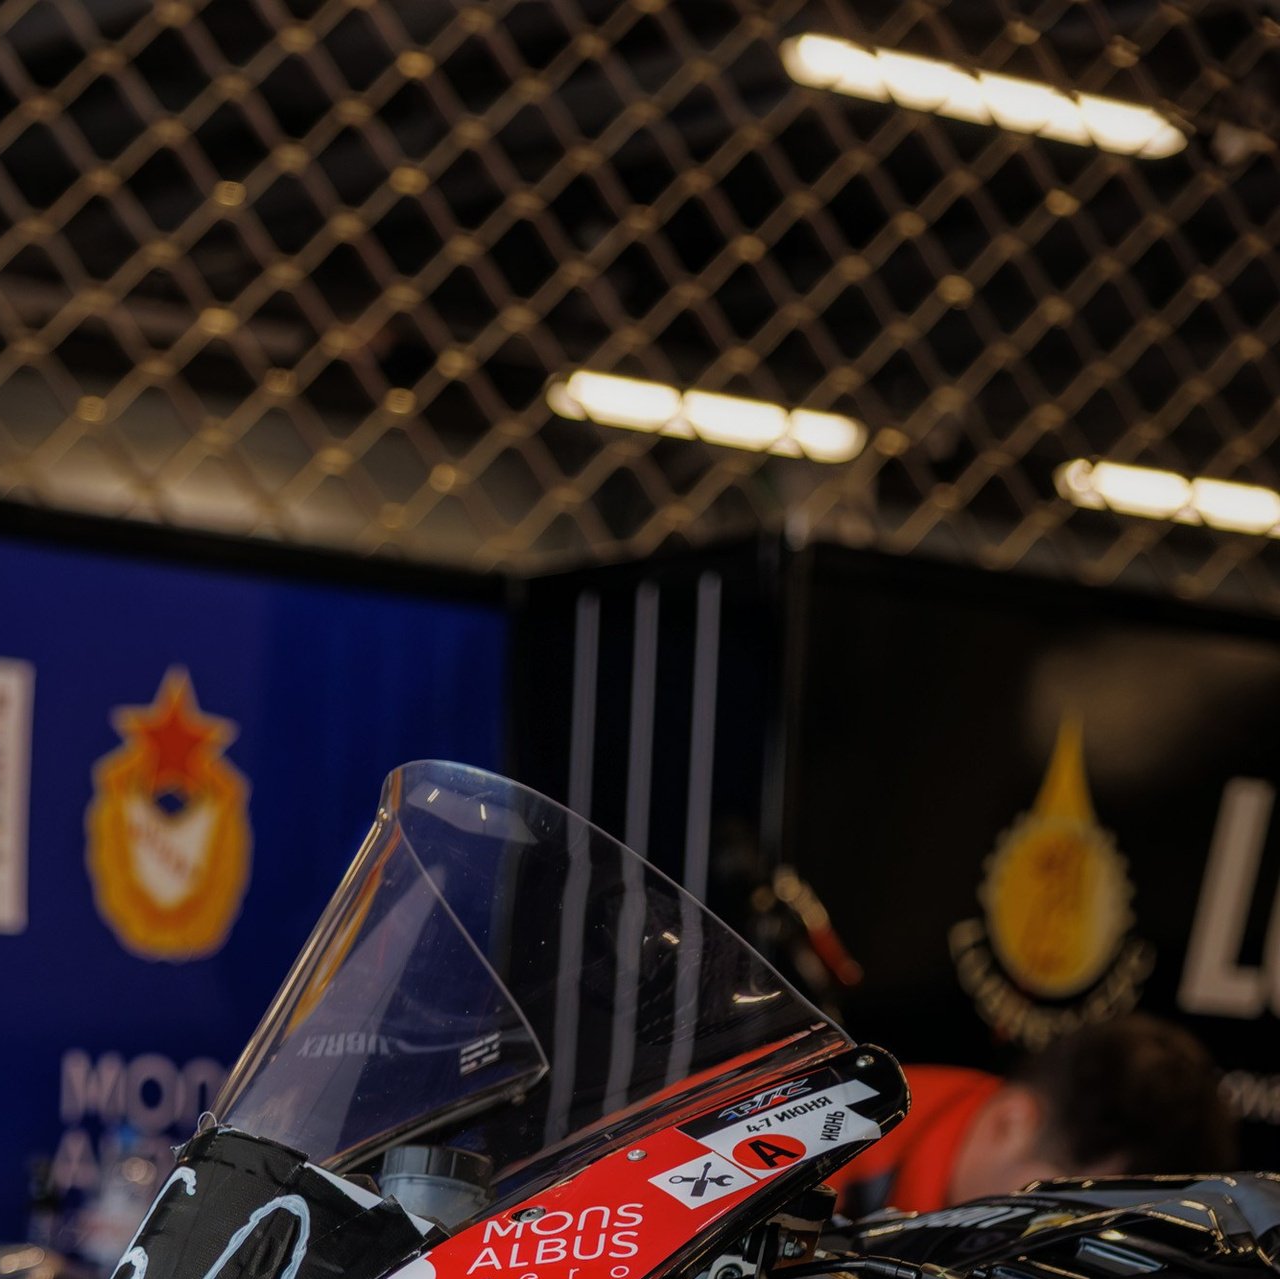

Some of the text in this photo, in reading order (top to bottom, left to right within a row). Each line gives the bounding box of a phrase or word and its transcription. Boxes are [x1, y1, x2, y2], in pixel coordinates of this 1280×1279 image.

[746, 1095, 834, 1134] 4-7 ИЮНЯ
[820, 1110, 845, 1142] ИЮНЬ
[466, 1231, 639, 1275] ALBUS
